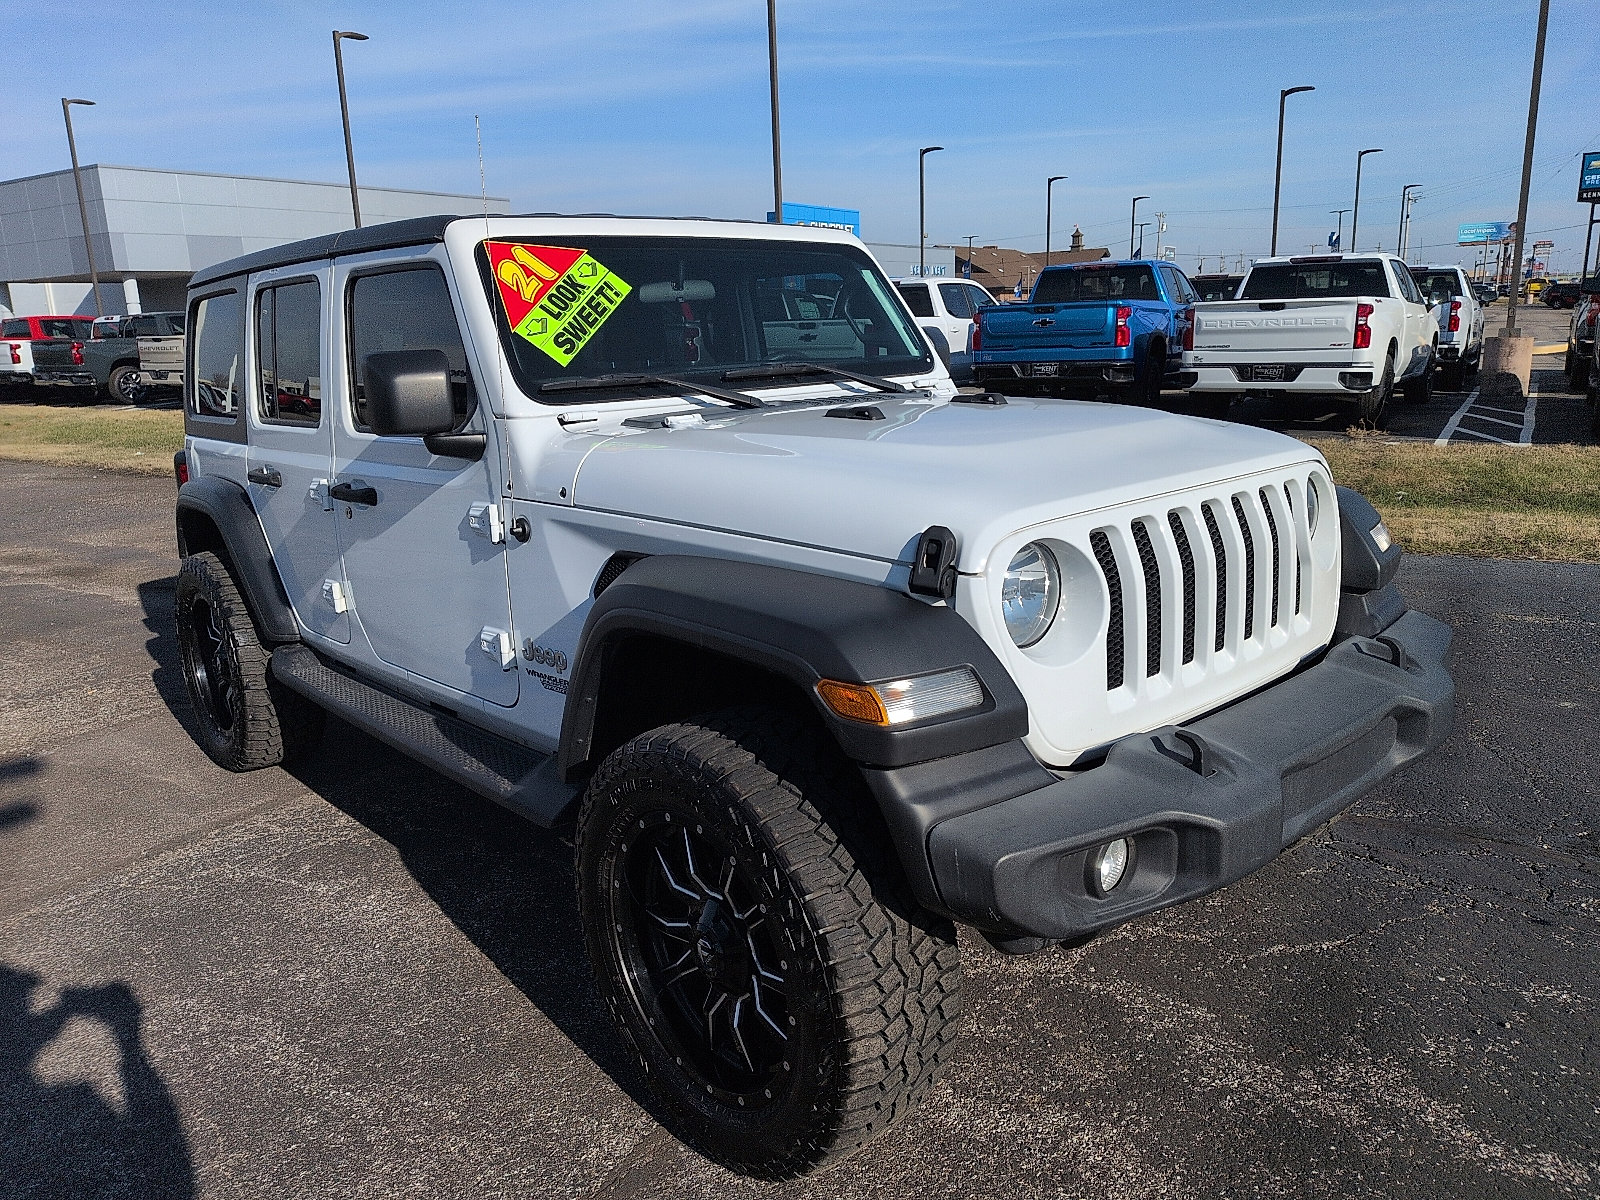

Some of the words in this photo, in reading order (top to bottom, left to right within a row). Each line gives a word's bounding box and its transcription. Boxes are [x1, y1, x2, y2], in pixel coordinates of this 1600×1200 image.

[497, 245, 560, 303] 21
[910, 265, 931, 276] KENY
[931, 265, 947, 277] KENT
[538, 273, 591, 322] LOOK
[553, 280, 624, 356] SWEET!
[1203, 317, 1345, 329] CHEVROLET
[1263, 368, 1283, 376] KENT
[521, 637, 568, 675] Jeep
[525, 667, 570, 687] WRANGLER
